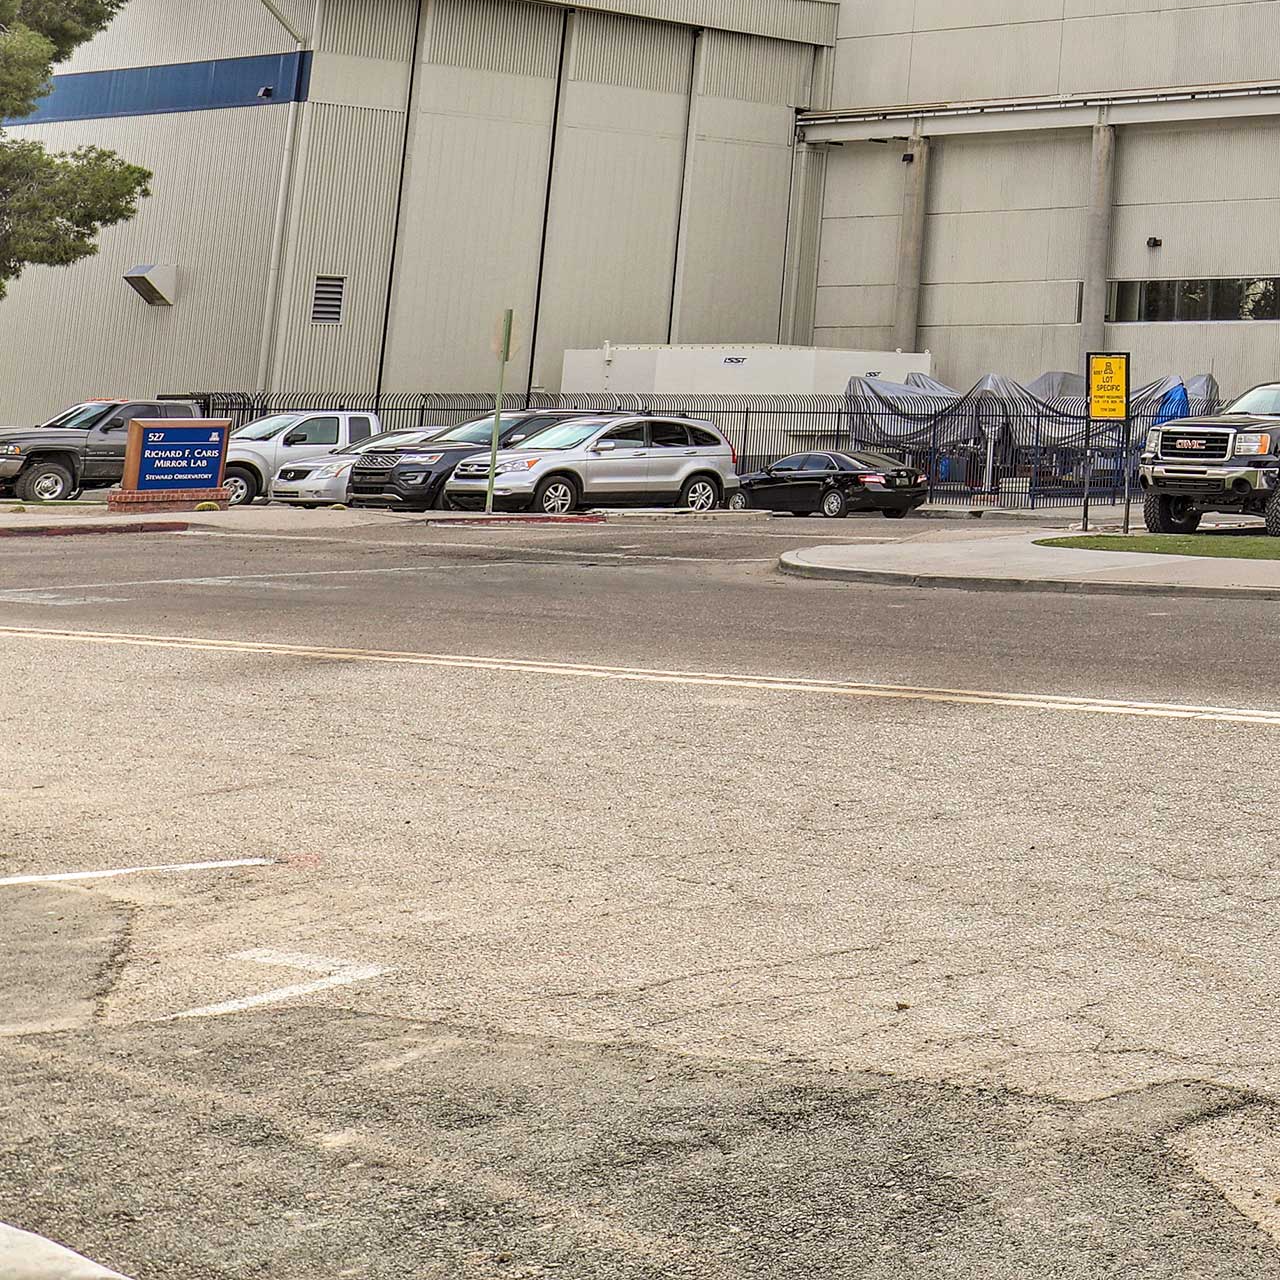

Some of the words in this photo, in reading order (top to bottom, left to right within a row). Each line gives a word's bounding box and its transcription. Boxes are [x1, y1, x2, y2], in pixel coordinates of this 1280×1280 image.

[1096, 384, 1121, 392] SPECIFIC
[148, 433, 165, 441] 527
[1175, 439, 1207, 449] GMC
[144, 449, 183, 458] RICHARD
[184, 449, 191, 458] F.
[194, 449, 219, 458] CARIS
[154, 459, 188, 468] MIRROR
[190, 459, 207, 467] LAB
